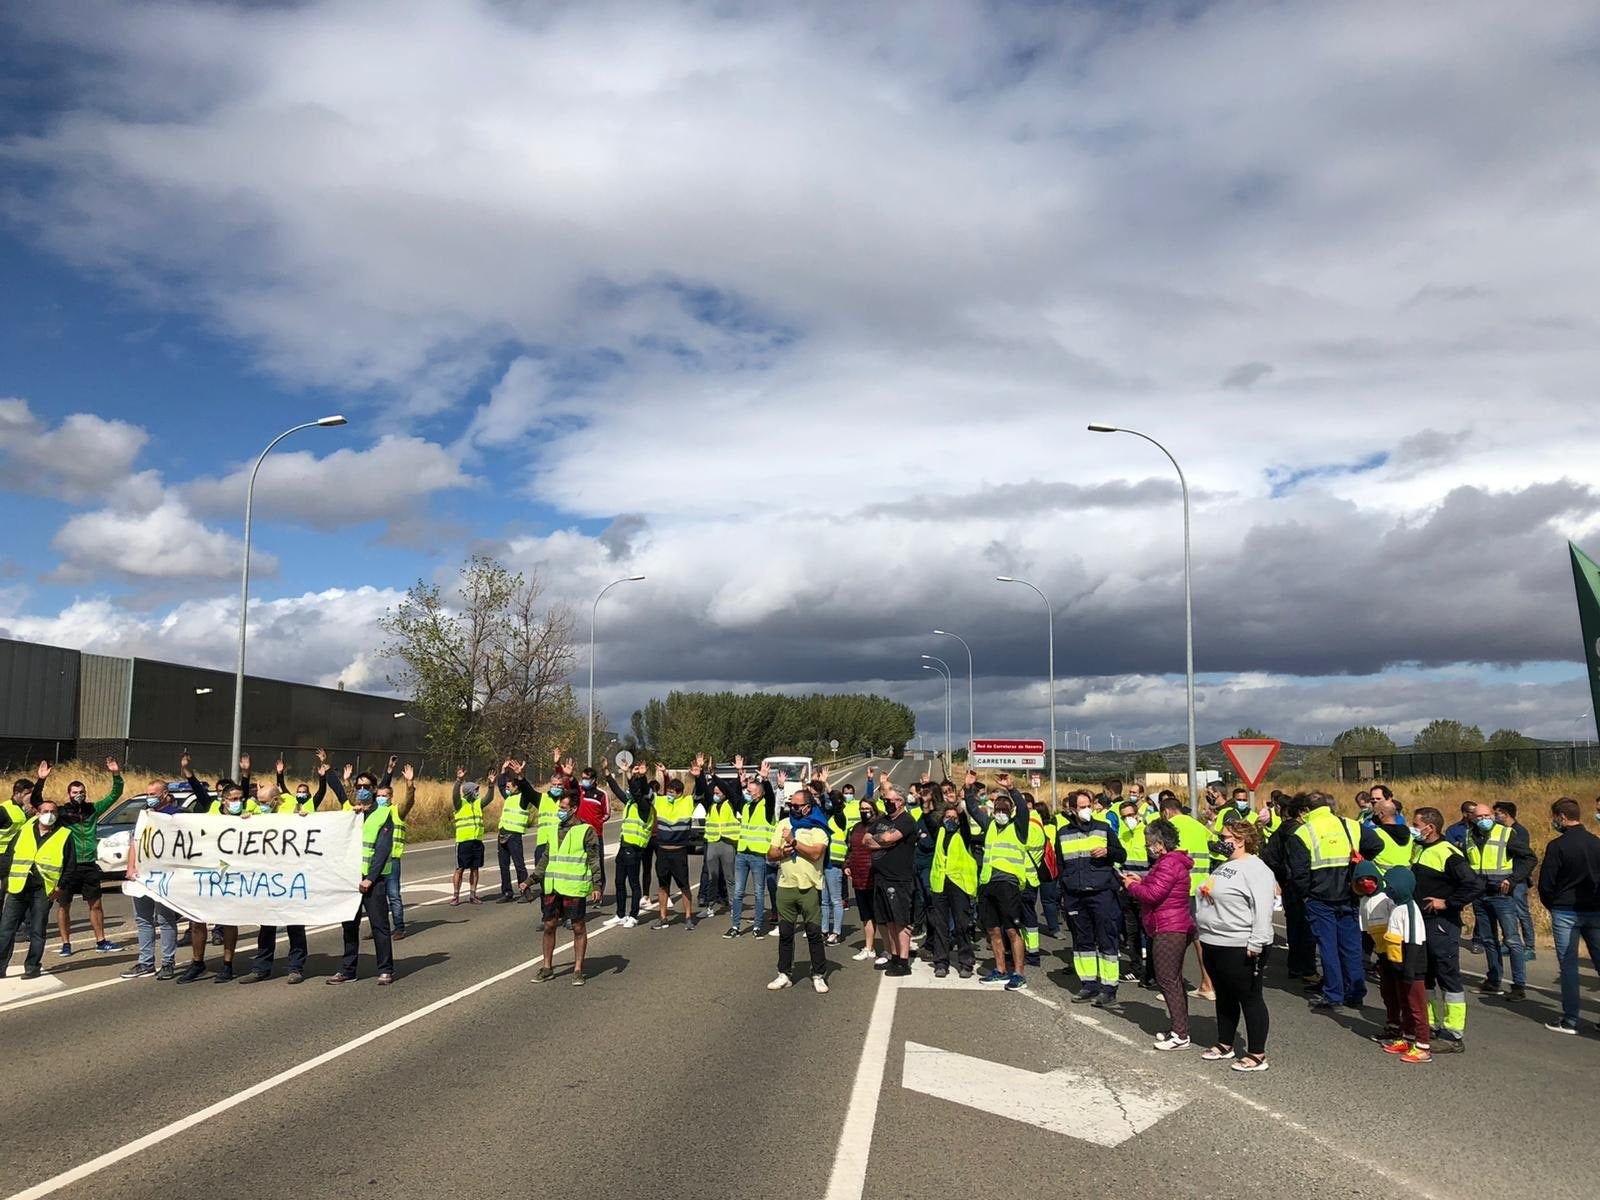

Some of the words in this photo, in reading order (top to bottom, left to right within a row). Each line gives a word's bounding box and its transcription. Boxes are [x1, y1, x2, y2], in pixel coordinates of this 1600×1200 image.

[138, 824, 165, 863] NO
[217, 828, 323, 857] CIERRE
[144, 871, 175, 896] EN
[193, 871, 308, 900] TRENASA
